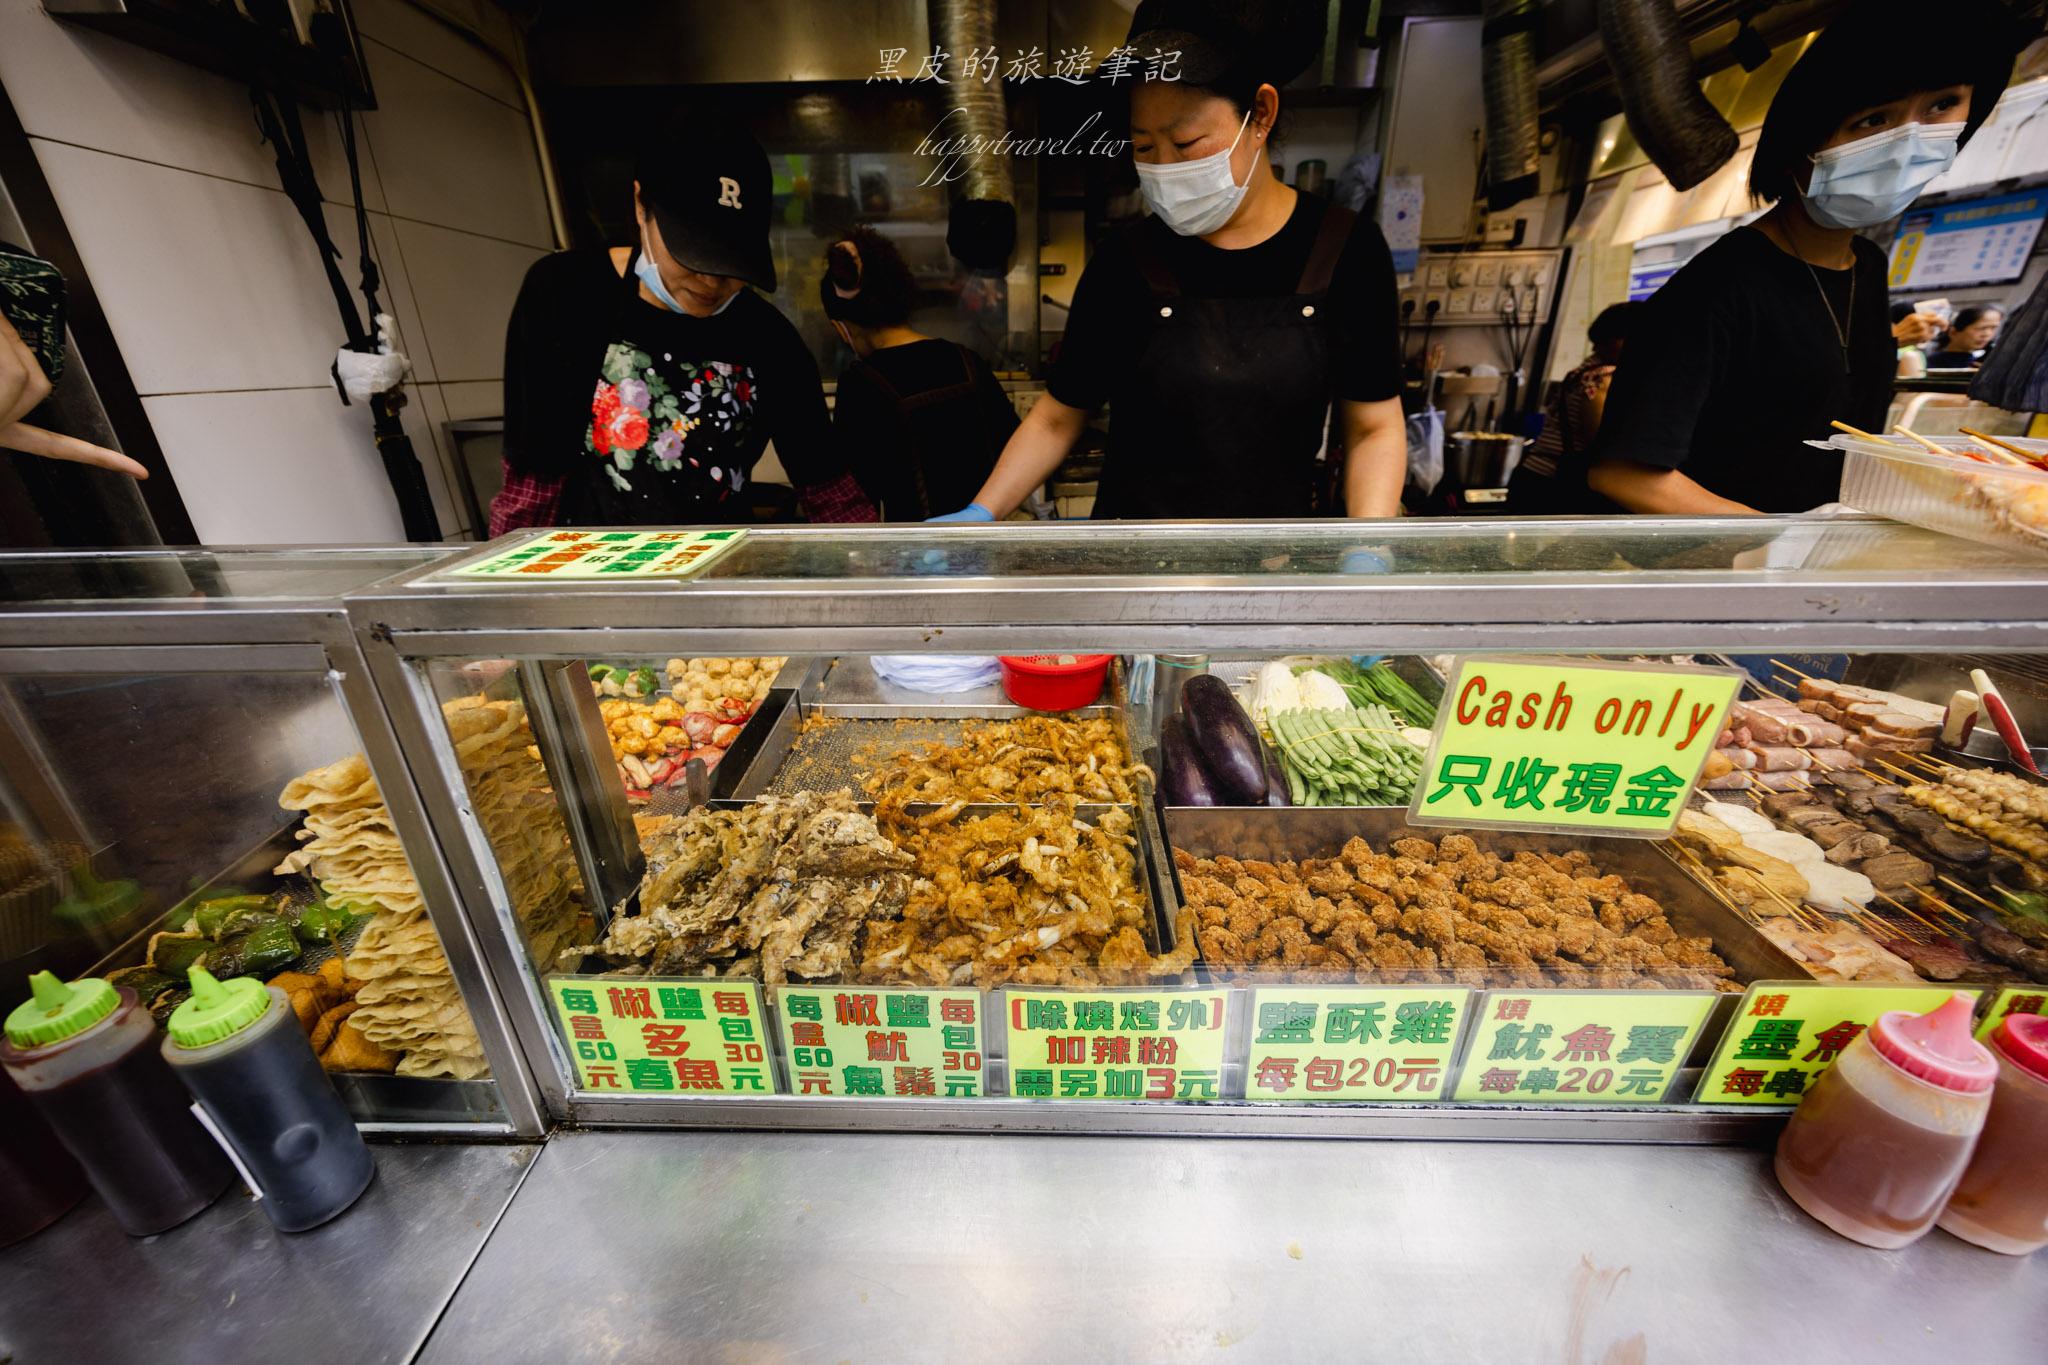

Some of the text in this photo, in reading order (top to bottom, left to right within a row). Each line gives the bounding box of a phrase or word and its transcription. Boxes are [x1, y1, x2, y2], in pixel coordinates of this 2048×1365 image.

[718, 176, 743, 210] R
[1456, 675, 1715, 751] Cash only
[1427, 754, 1687, 818] 只收現金
[607, 987, 707, 1021] 椒鹽
[834, 993, 930, 1028] 椒鹽
[1494, 999, 1533, 1021] 燒
[1748, 993, 1791, 1017] 燒
[560, 987, 621, 1089] 每盒60元
[641, 1023, 691, 1057] 多
[1254, 1001, 1457, 1045] 鹽酥雞
[713, 991, 766, 1091] 每包30元
[786, 993, 834, 1096] 每盒60元
[866, 1031, 910, 1062] 魷
[940, 998, 982, 1097] 每包30元
[1045, 1036, 1179, 1065] 加辣粉
[1486, 1022, 1689, 1065] 魷魚翼
[625, 1058, 724, 1091] 春魚
[1014, 1068, 1219, 1099] 需另加3元
[1254, 1056, 1441, 1093] 每包20元
[1479, 1067, 1665, 1096] 每串20元
